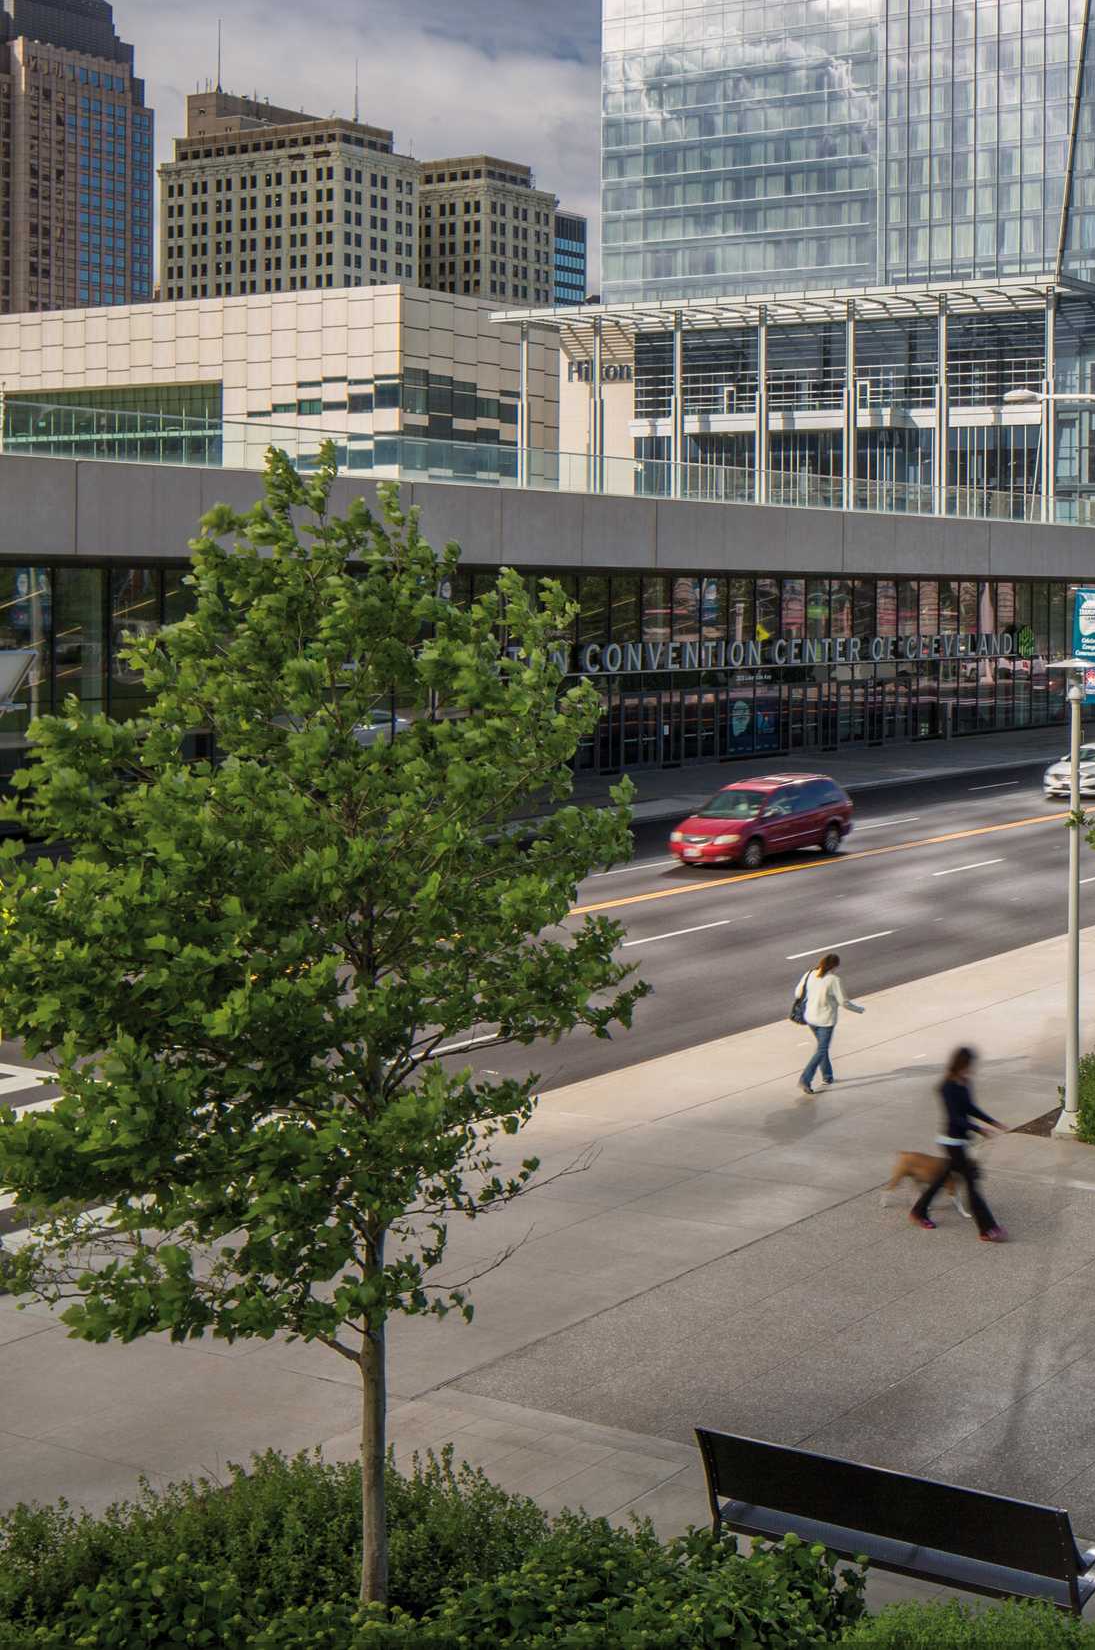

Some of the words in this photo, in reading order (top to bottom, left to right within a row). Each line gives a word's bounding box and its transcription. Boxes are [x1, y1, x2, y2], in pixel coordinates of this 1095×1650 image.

[583, 637, 761, 672] CONVENTION
[774, 635, 861, 667] CENTER
[872, 634, 896, 662] OF
[906, 631, 1014, 659] CLEVELAND
